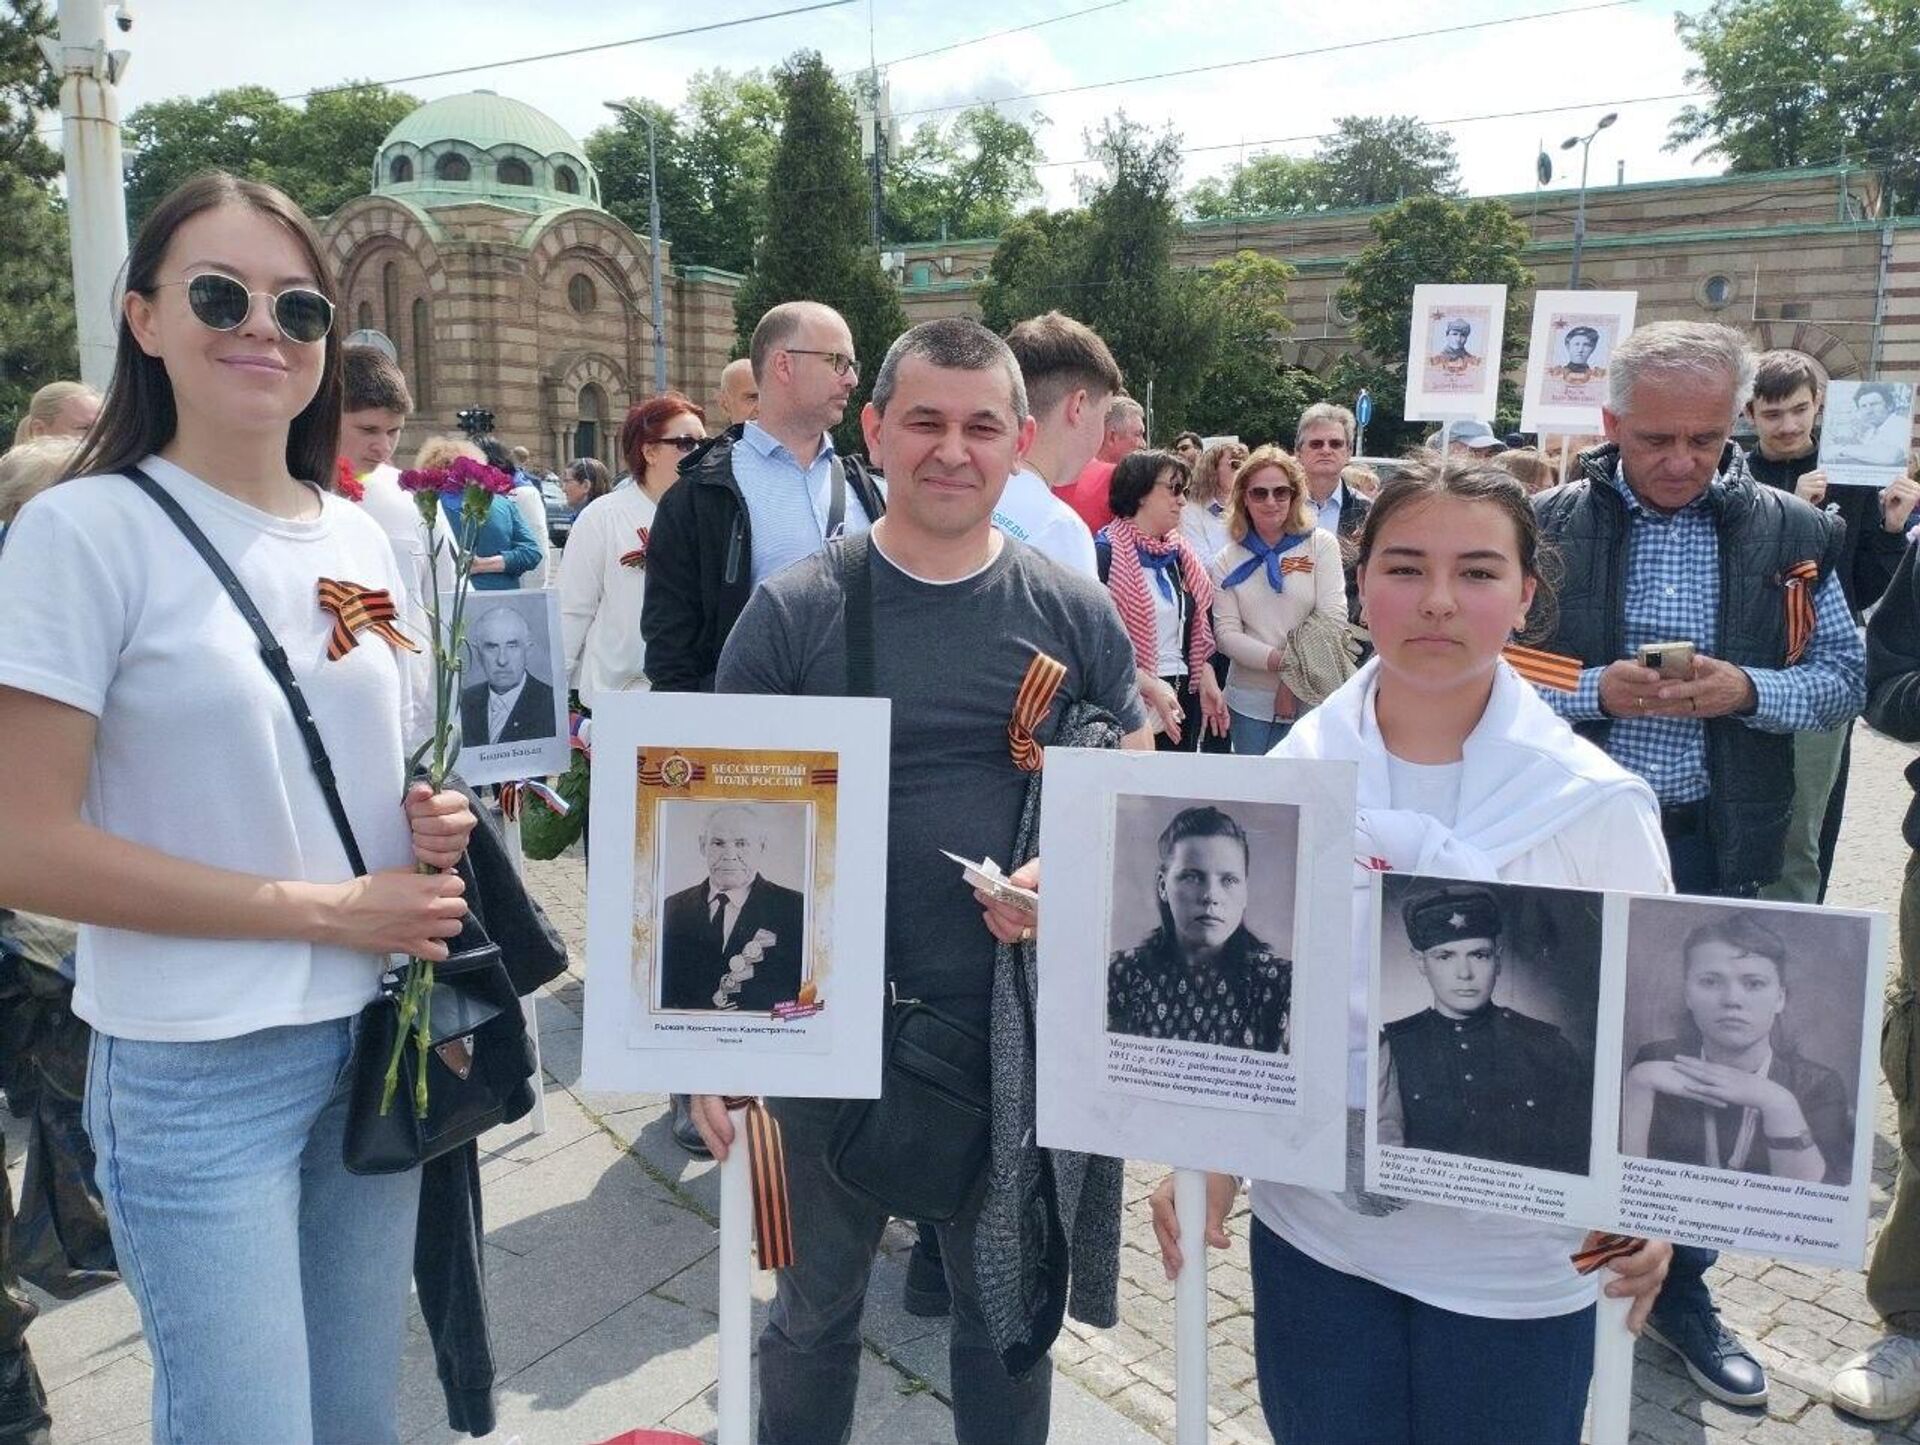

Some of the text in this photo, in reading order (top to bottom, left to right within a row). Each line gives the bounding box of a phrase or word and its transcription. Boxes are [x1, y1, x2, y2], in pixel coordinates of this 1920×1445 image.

[992, 511, 1029, 541] ОБЕДЫ
[711, 763, 807, 776] БЕССМЕРТНЫЙ
[714, 775, 802, 787] ПОЛК РОССИИ
[1238, 1069, 1252, 1077] по
[1743, 1178, 1792, 1194] Татьяна
[1622, 1184, 1693, 1203] Медицинская
[1695, 1197, 1735, 1210] сестра
[1620, 1207, 1627, 1216] 9
[1628, 1211, 1649, 1220] мая
[1652, 1213, 1677, 1223] 1945
[1743, 1226, 1783, 1242] Победу
